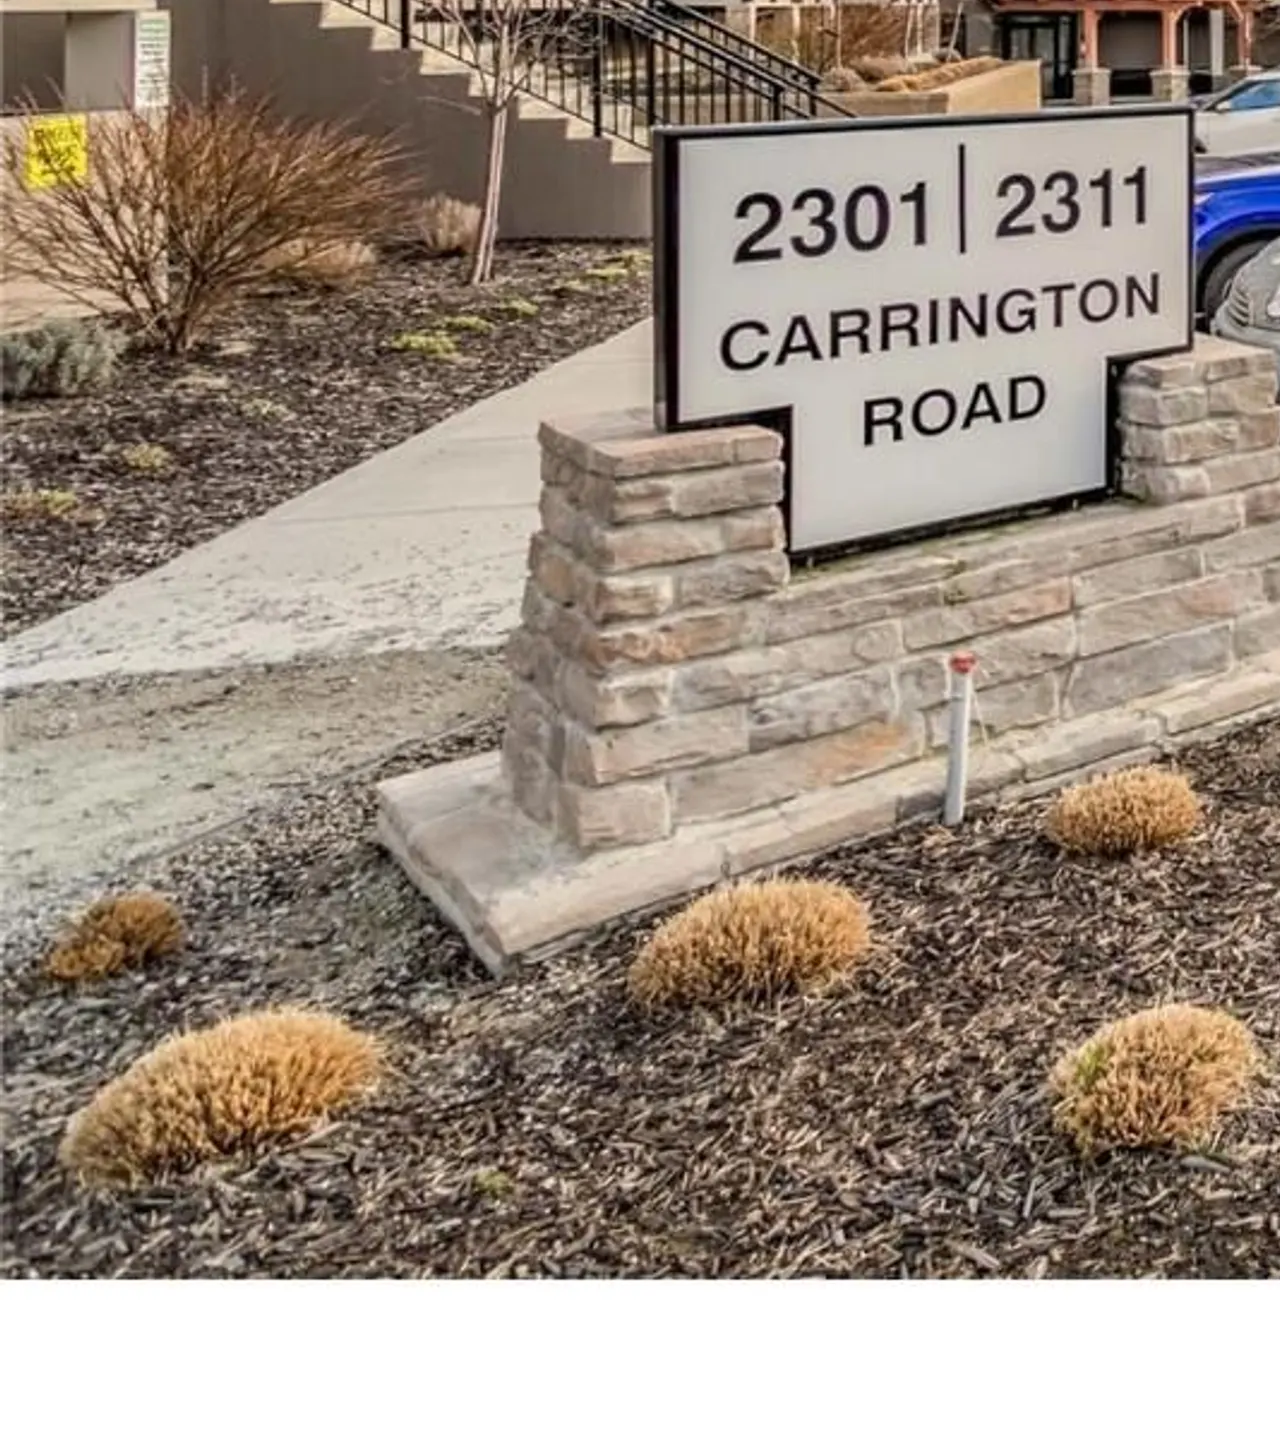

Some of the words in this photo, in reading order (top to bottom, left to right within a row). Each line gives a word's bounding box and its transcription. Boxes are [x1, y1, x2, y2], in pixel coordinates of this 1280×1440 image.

[733, 182, 928, 263] 2301
[995, 165, 1148, 239] 2311
[719, 272, 1161, 372] CARRINGTON
[863, 375, 1047, 447] ROAD
